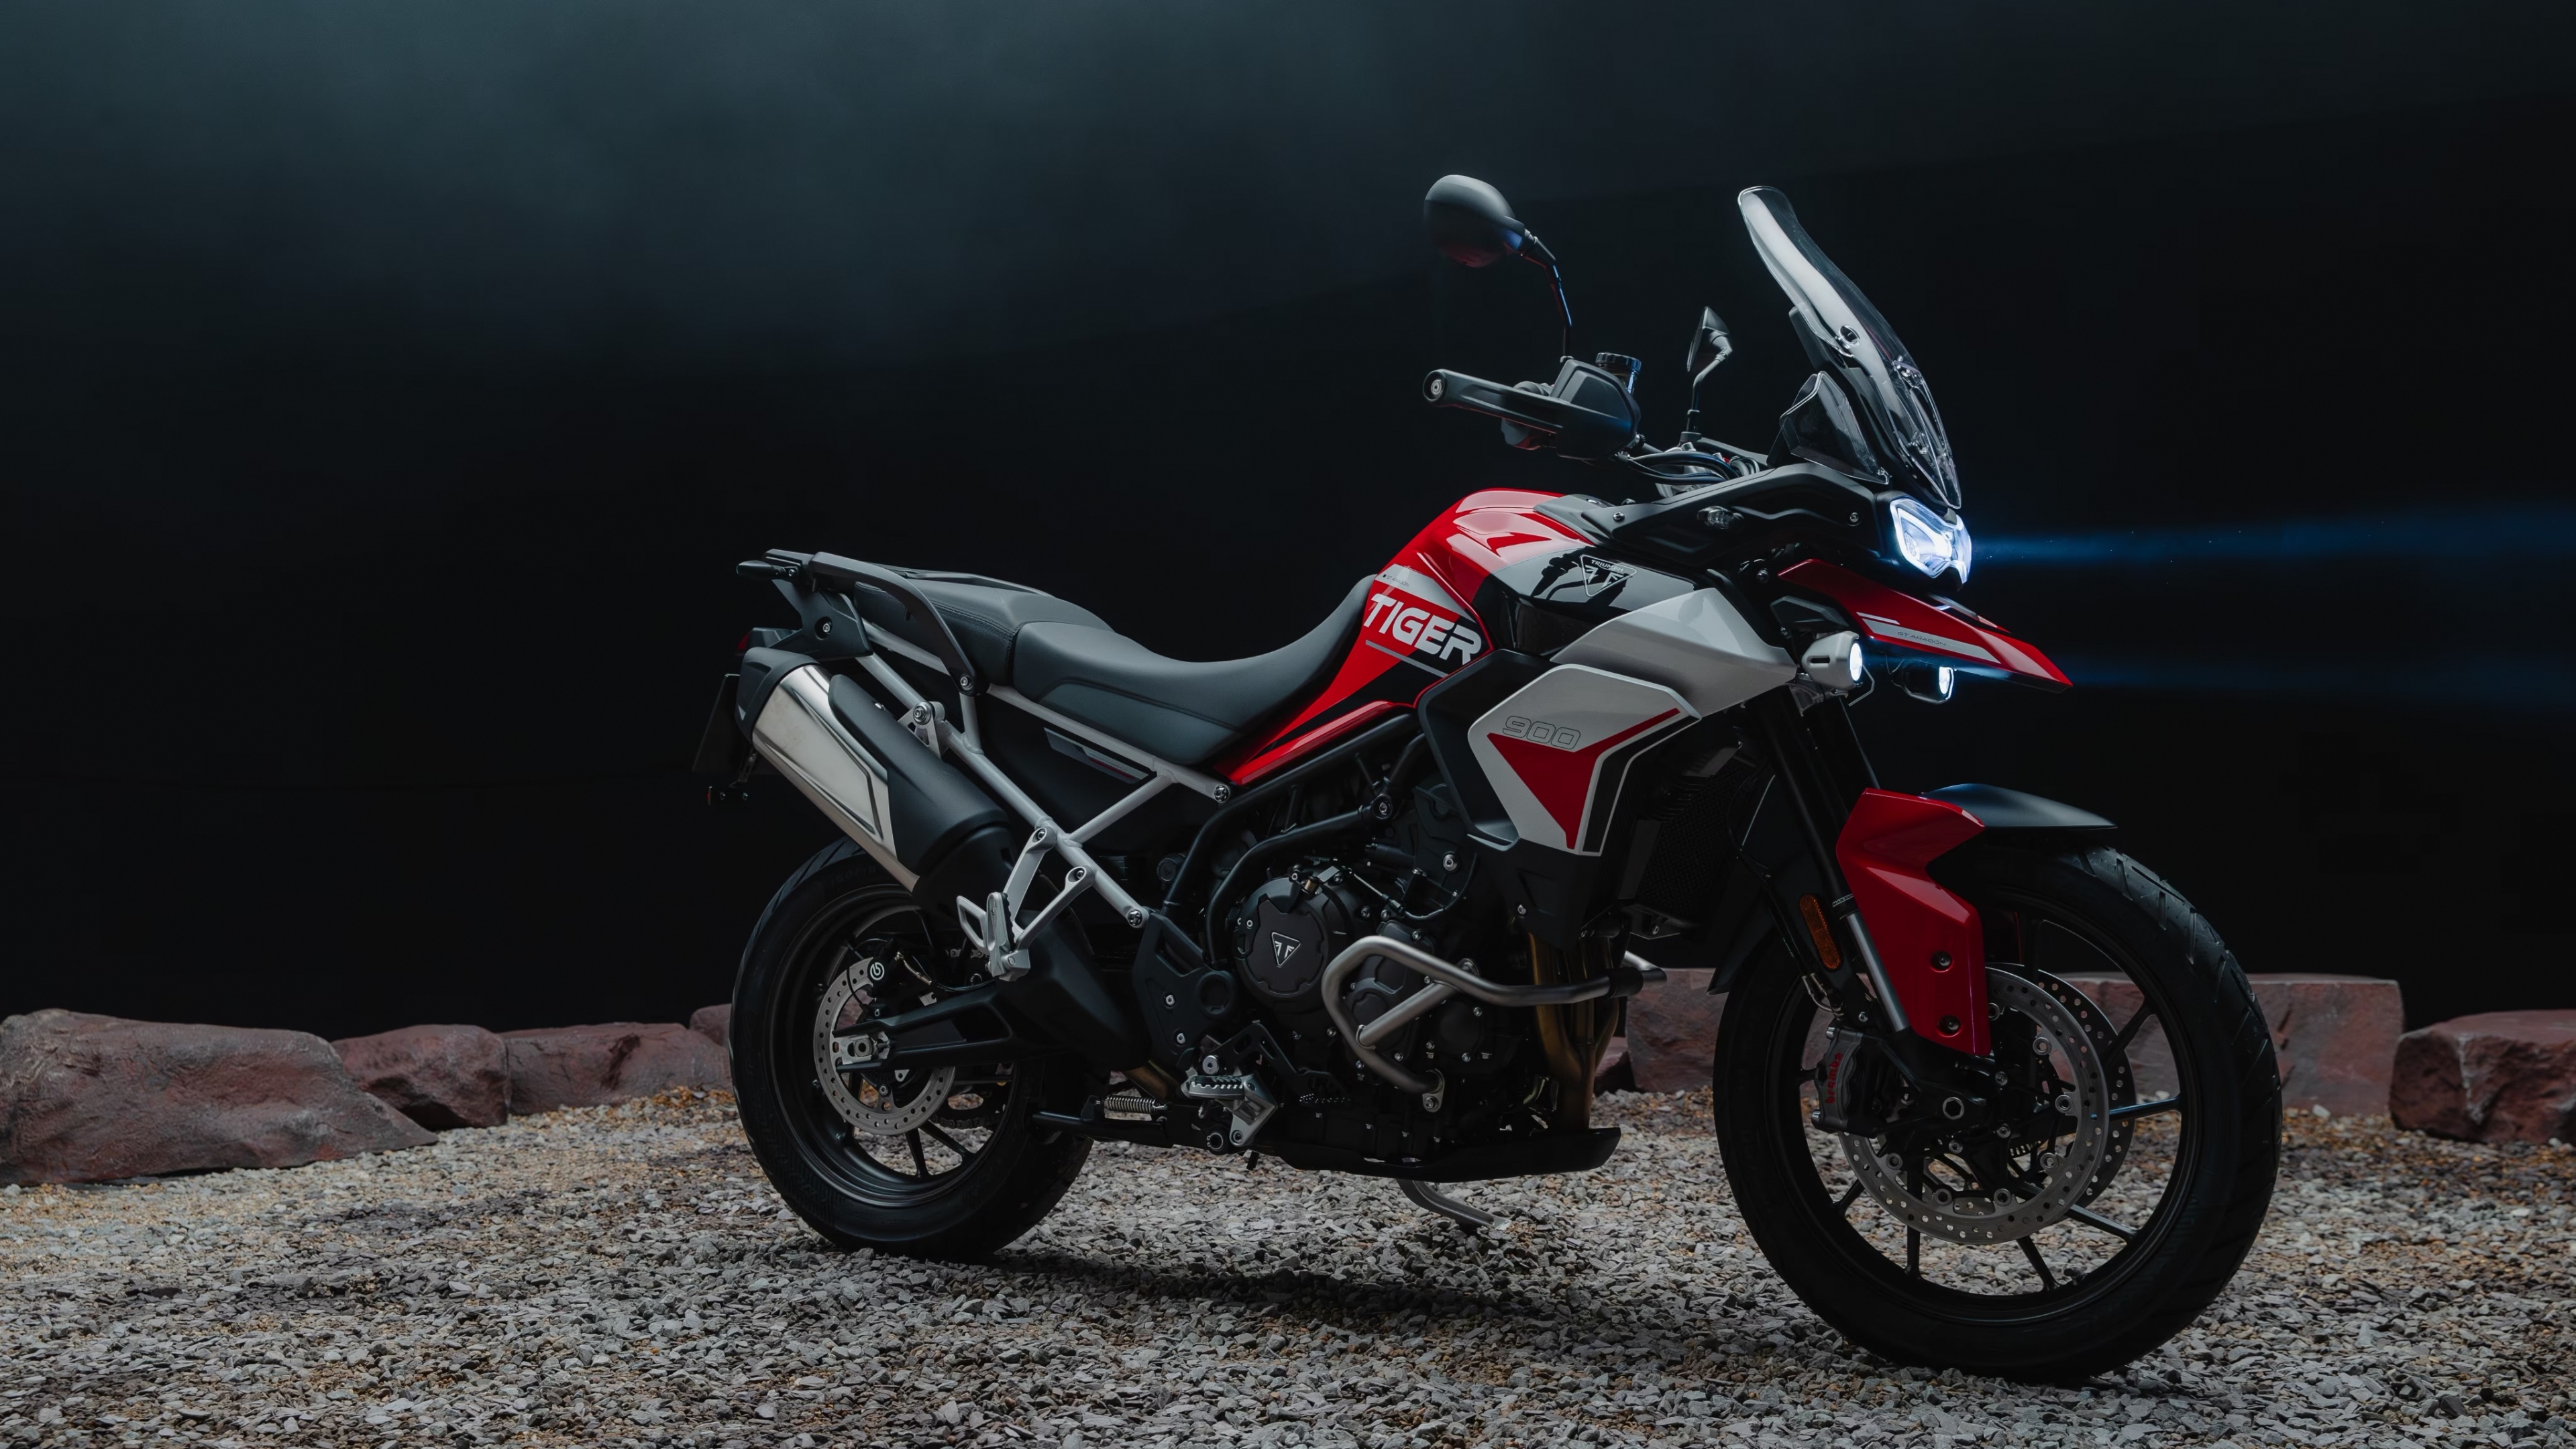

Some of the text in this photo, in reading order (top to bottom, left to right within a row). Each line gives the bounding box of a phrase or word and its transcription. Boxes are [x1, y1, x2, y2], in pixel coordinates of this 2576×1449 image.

[1591, 559, 1624, 572] TRIUMPH
[1363, 593, 1482, 665] TIGER
[1503, 715, 1581, 749] 900
